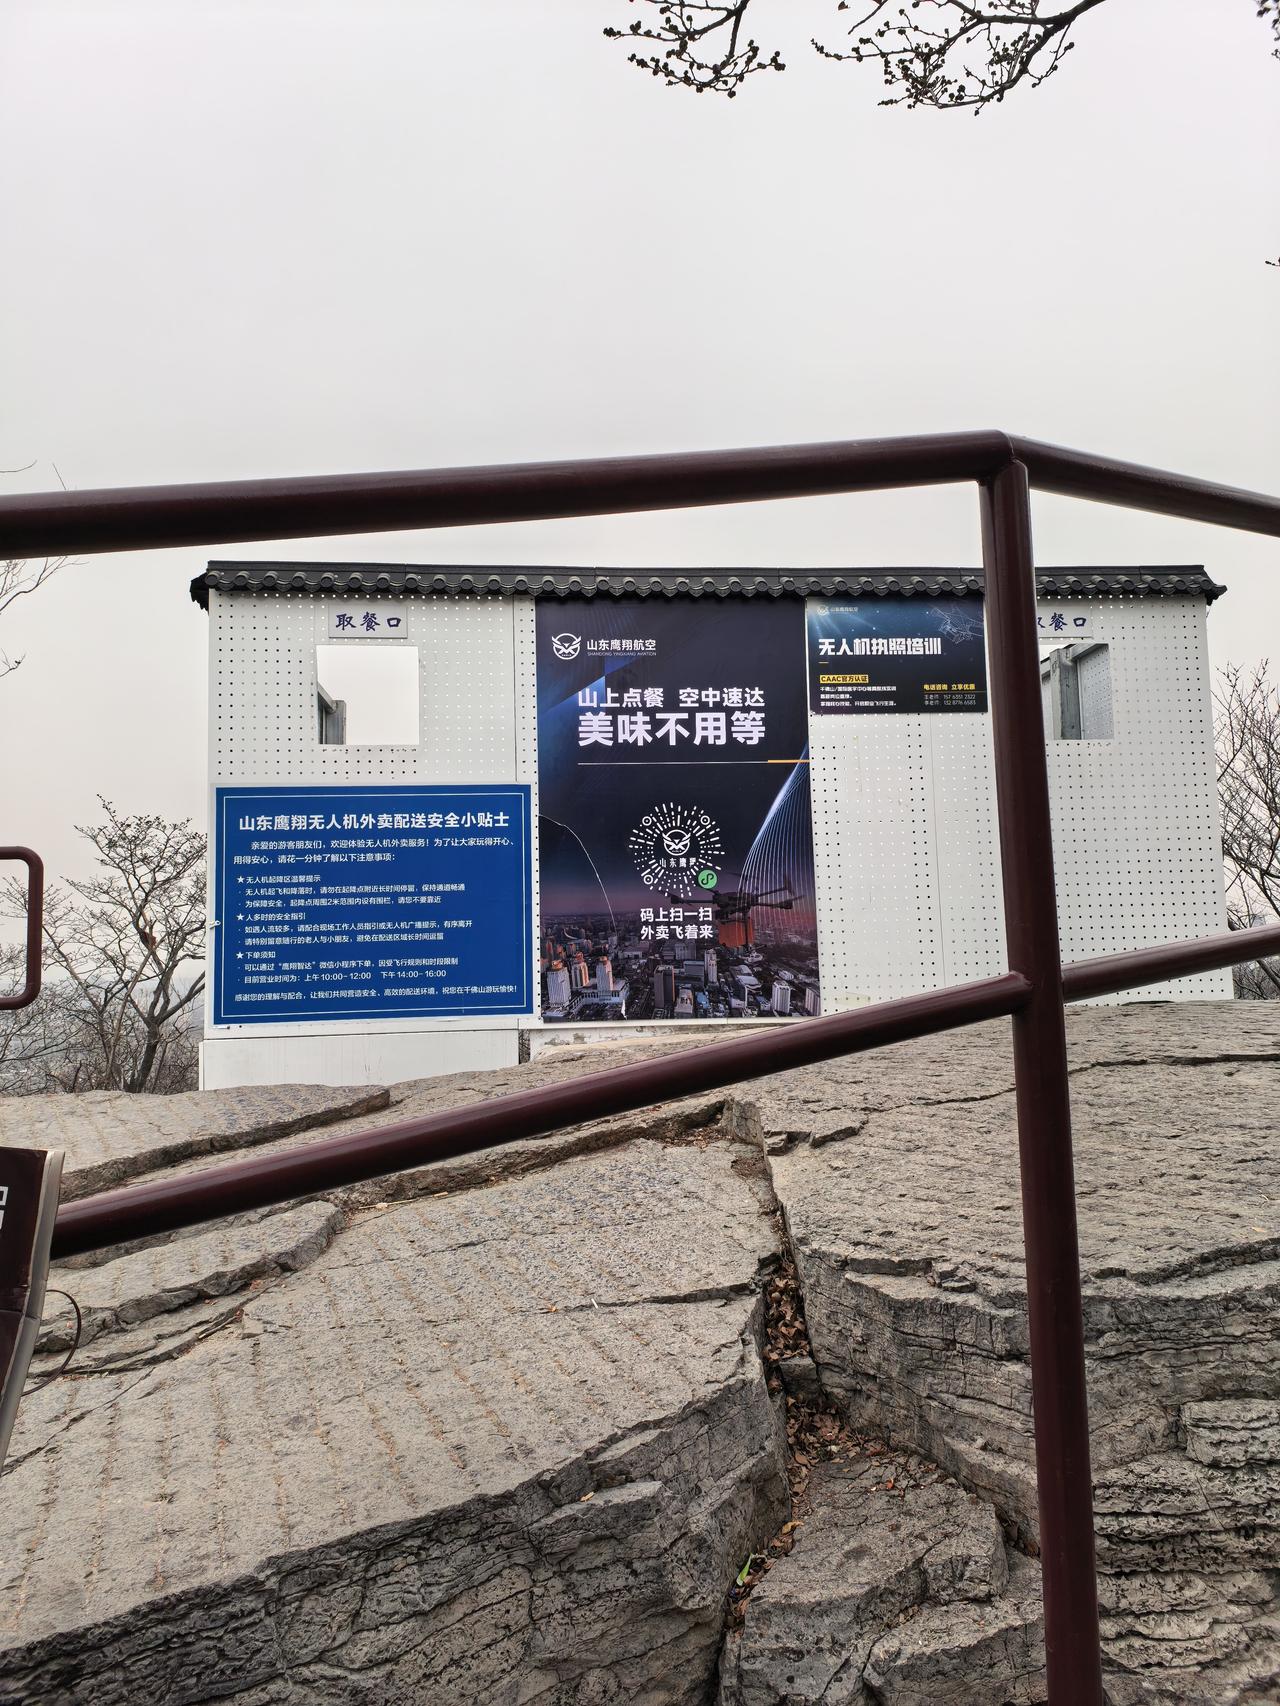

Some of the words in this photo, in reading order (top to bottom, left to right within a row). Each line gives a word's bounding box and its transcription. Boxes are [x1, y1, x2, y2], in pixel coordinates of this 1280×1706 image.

[335, 611, 402, 632] 取餐口
[587, 638, 656, 652] 山东鹰翔航空
[818, 637, 942, 656] 无人机执照培训
[577, 687, 664, 708] 山上点餐
[679, 687, 765, 708] 空中速达
[577, 711, 766, 747] 美味不用等
[239, 812, 510, 831] 山东鹰翔无人机外卖配送安全小贴士
[246, 874, 321, 885] 无人机起降区温馨提示
[245, 912, 306, 922] 人多时的安全指引
[640, 907, 713, 922] 码上扫一扫
[640, 924, 714, 940] 外卖飞着来
[245, 950, 276, 960] 下单须知
